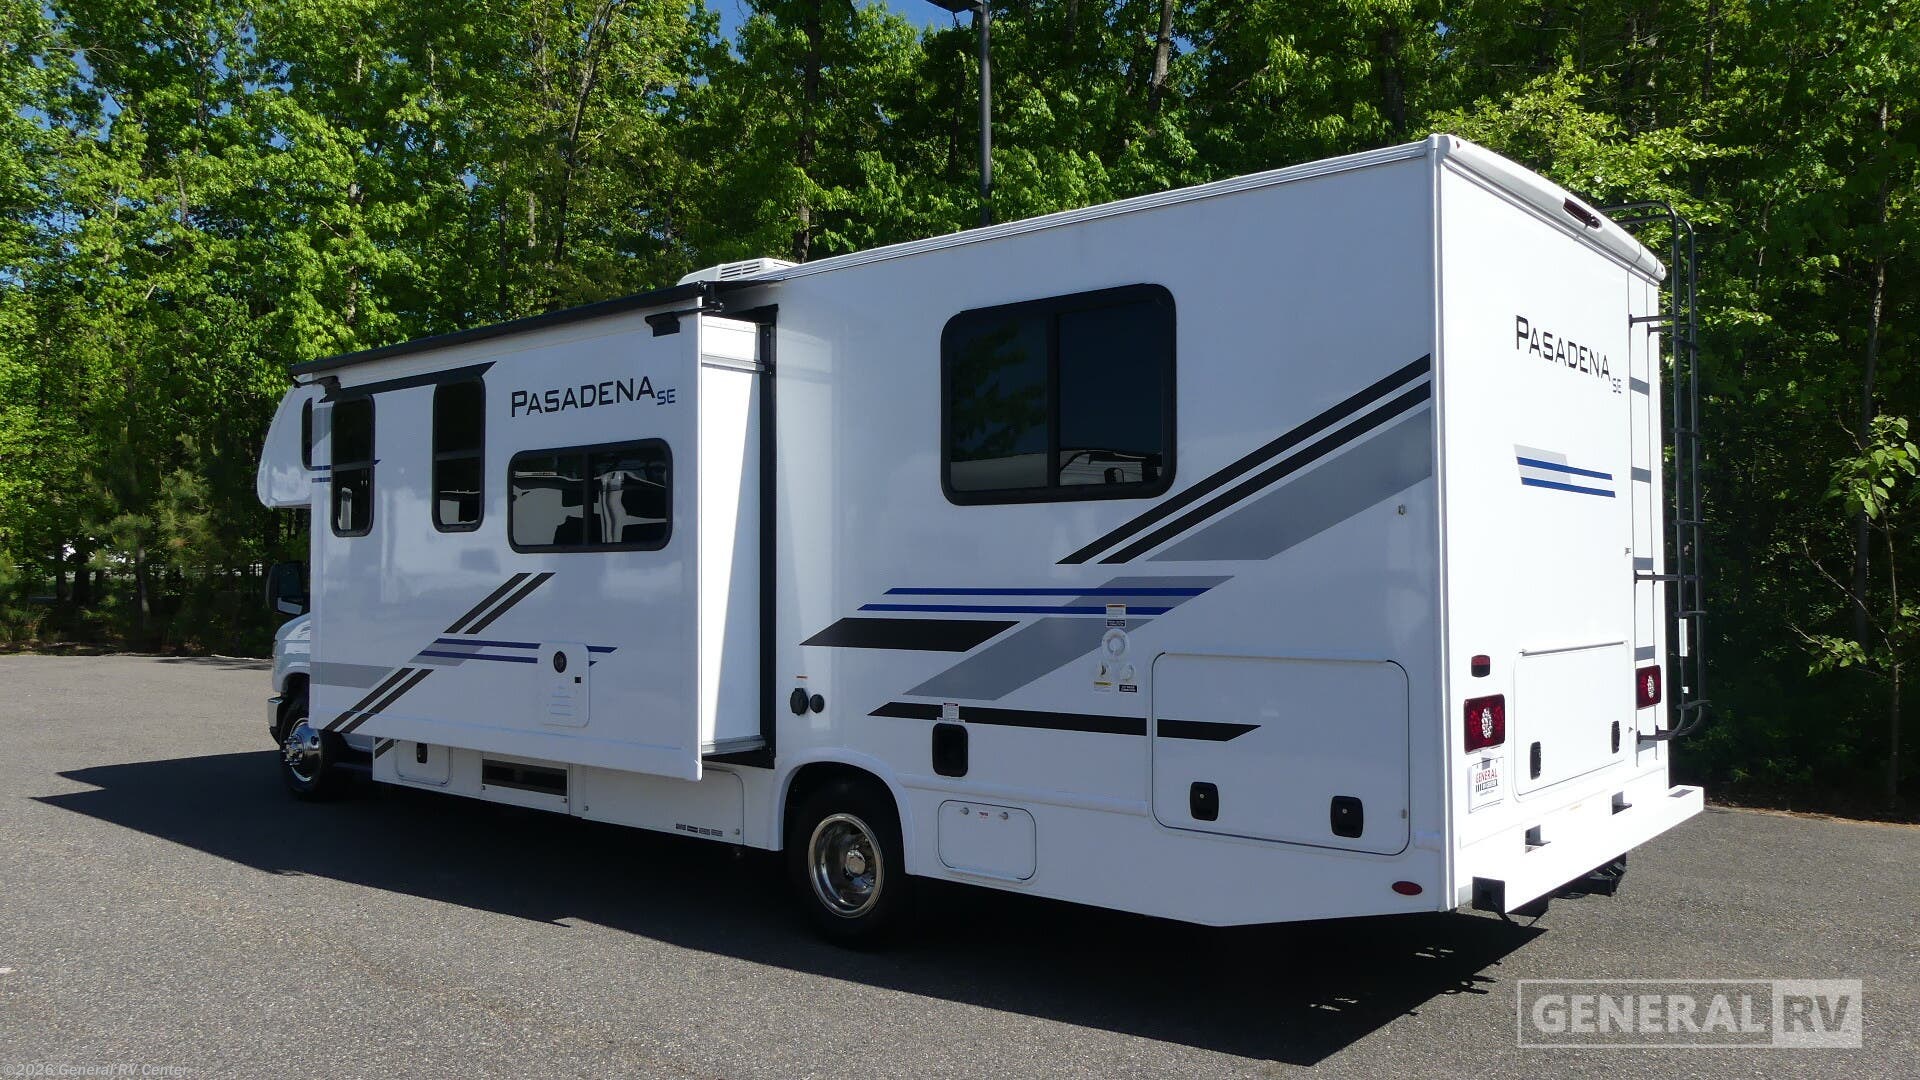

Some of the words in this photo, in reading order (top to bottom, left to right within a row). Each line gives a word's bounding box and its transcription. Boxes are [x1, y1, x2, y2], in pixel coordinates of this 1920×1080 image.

[1516, 315, 1611, 382] PASADENA
[1612, 378, 1622, 394] SE
[511, 376, 656, 418] PASADENA
[656, 388, 676, 406] SE
[1475, 768, 1498, 783] GENERAL
